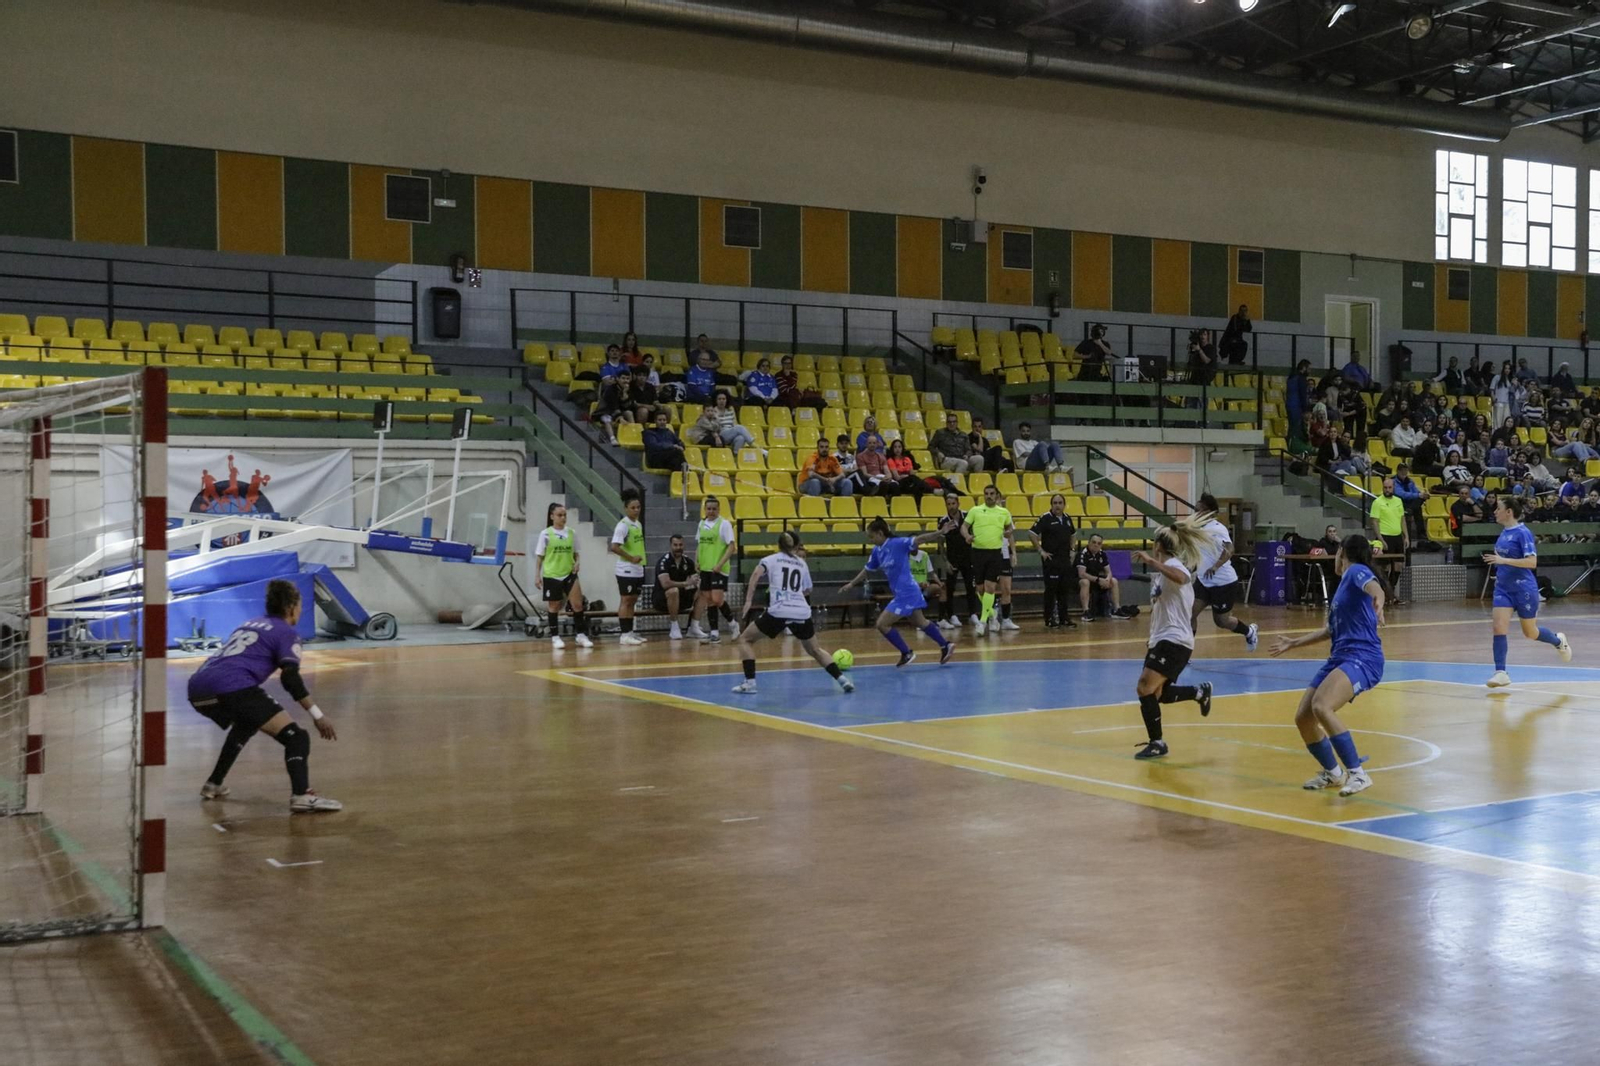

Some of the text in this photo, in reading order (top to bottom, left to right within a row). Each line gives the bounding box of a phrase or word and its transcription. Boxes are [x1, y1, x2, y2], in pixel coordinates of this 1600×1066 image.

[782, 567, 801, 593] 10
[545, 589, 551, 598] 6
[627, 585, 633, 593] 9
